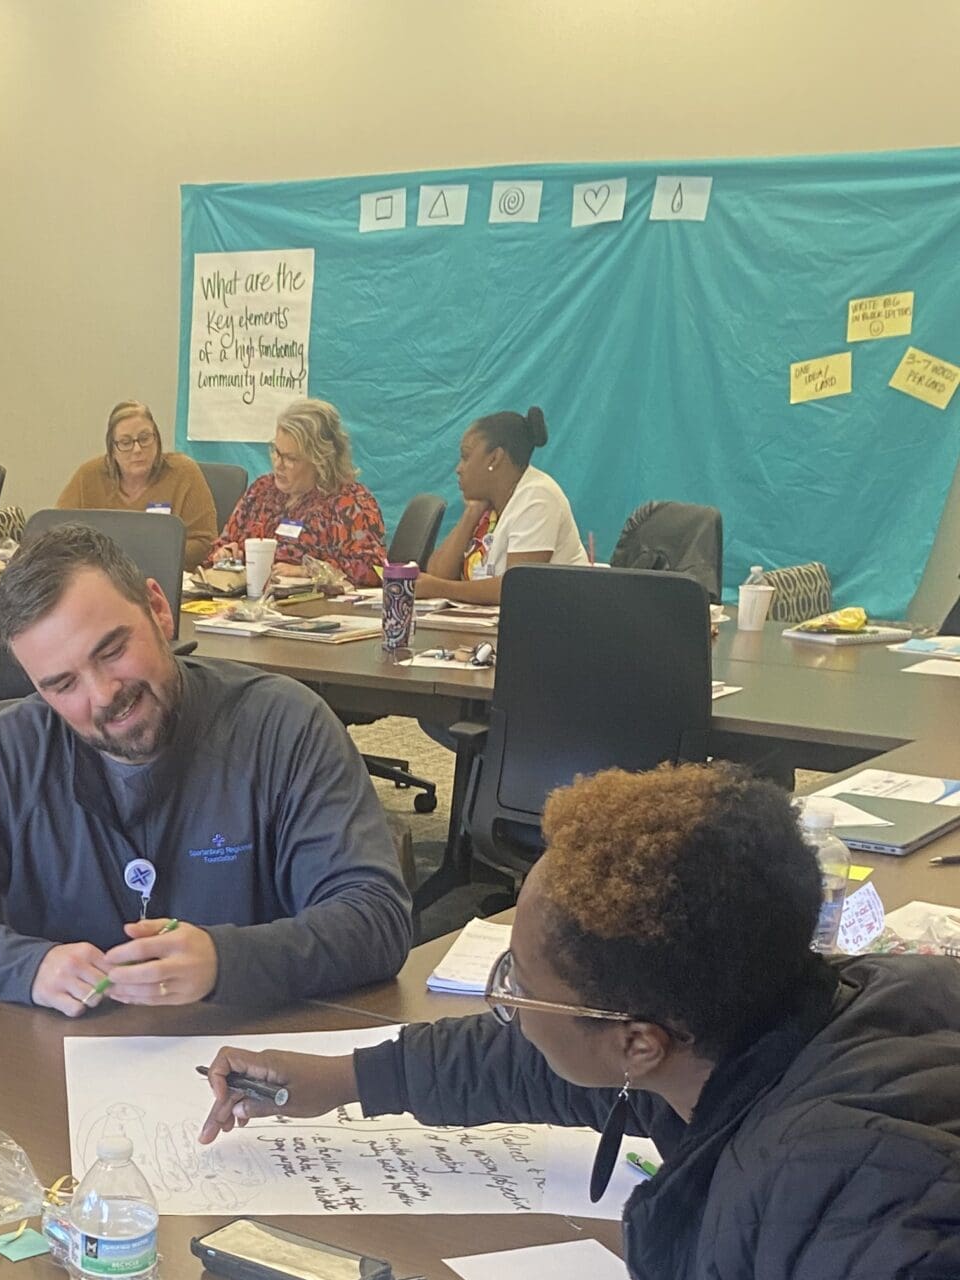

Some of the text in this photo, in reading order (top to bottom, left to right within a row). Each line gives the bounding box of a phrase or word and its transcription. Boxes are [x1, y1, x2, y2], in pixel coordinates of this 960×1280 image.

[201, 262, 306, 308] What are the
[851, 299, 878, 313] WRITE
[207, 306, 290, 349] Key elements
[199, 341, 213, 364] of
[219, 349, 229, 362] a
[794, 364, 810, 379] ONE
